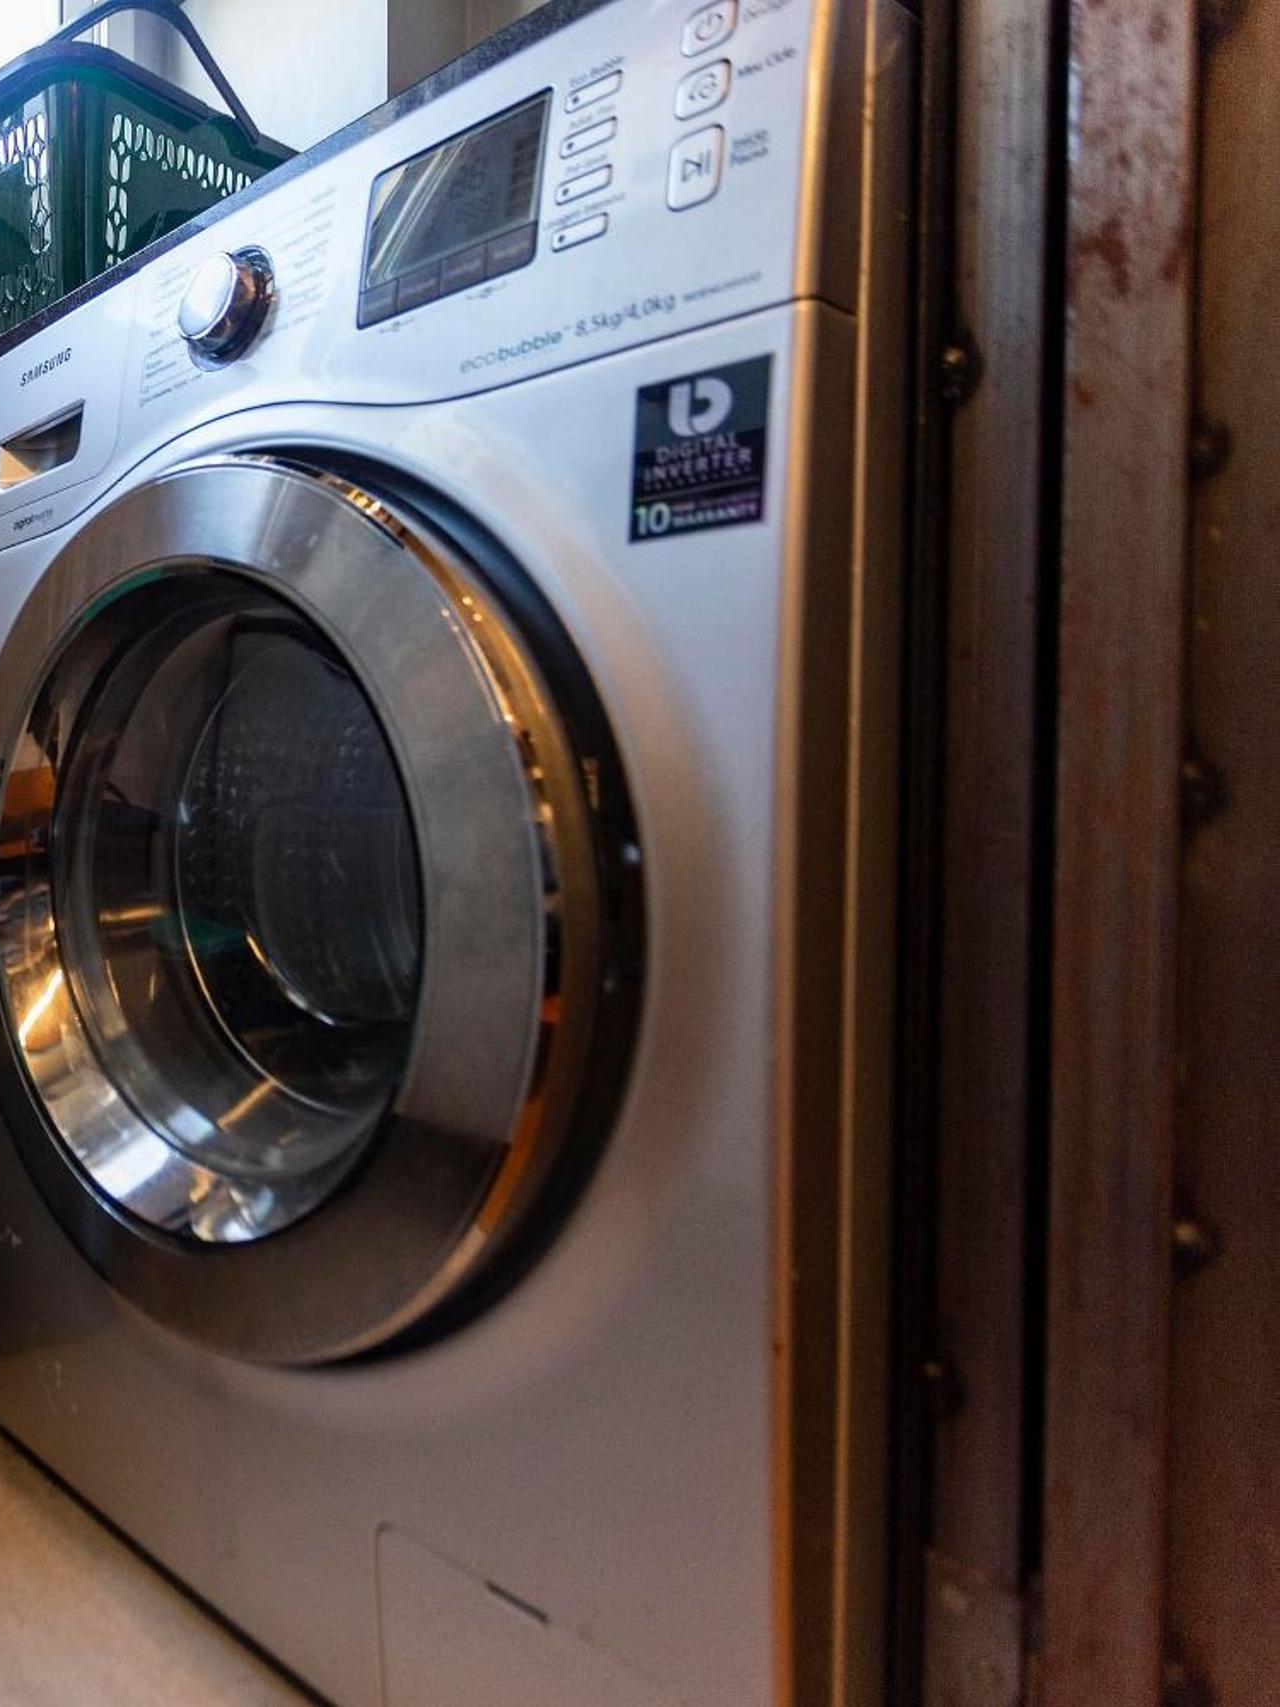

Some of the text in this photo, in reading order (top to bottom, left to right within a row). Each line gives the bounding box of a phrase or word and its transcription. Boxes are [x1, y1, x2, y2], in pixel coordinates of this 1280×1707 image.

[20, 347, 72, 387] SAMSUNG
[655, 432, 740, 464] DIGITAL
[643, 448, 753, 483] INVERTER
[635, 502, 670, 536] 10
